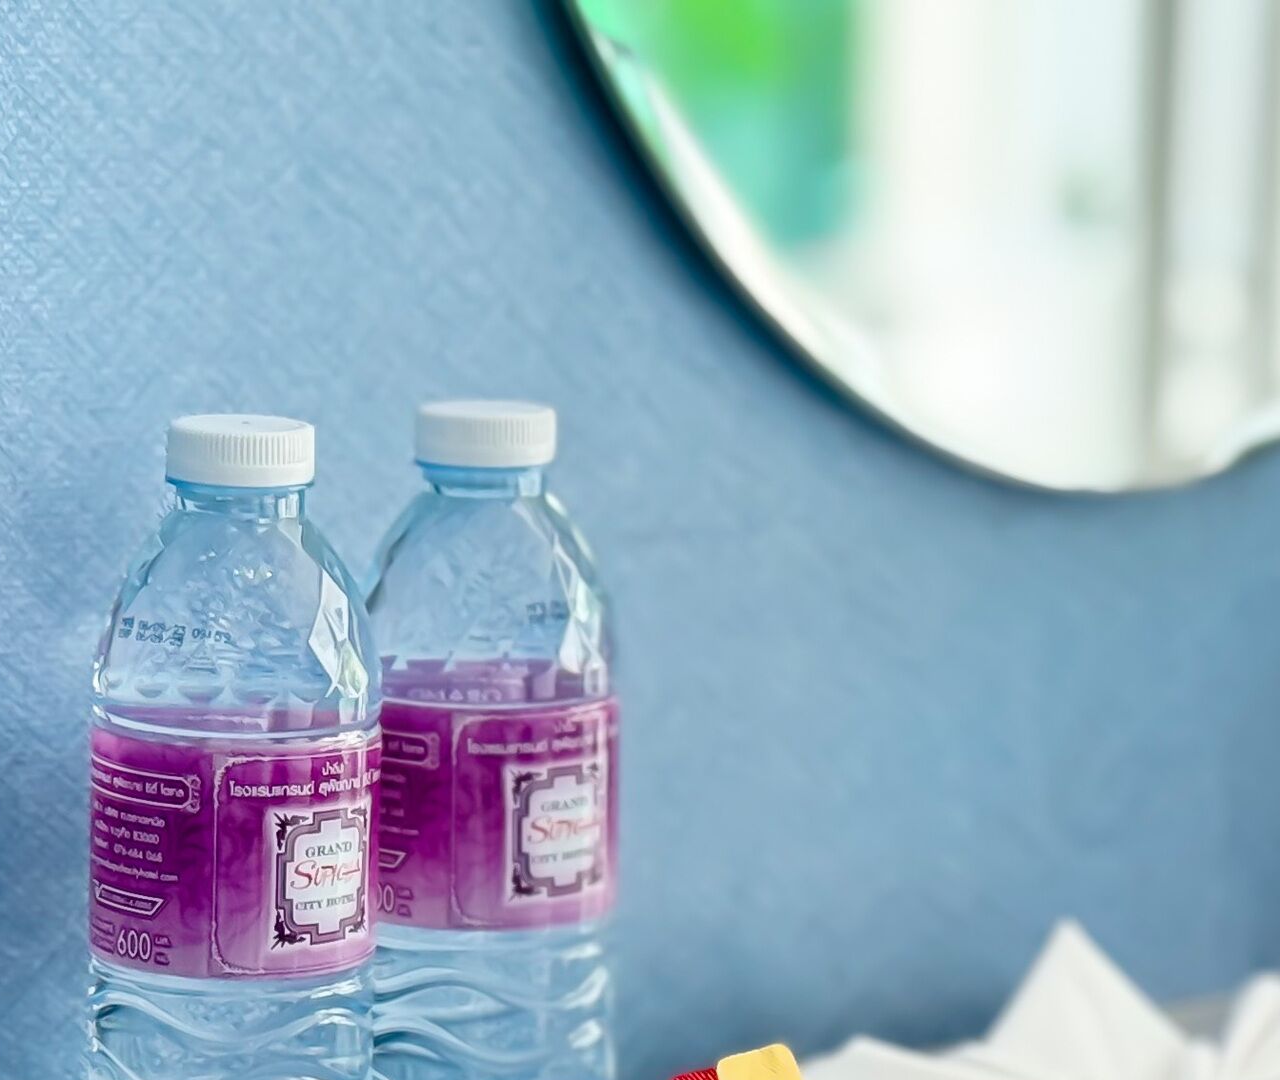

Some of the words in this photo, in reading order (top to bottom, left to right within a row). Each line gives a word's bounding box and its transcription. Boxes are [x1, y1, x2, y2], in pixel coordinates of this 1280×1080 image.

[305, 841, 353, 859] GRAND
[295, 899, 324, 911] CITY
[116, 928, 152, 961] 600
